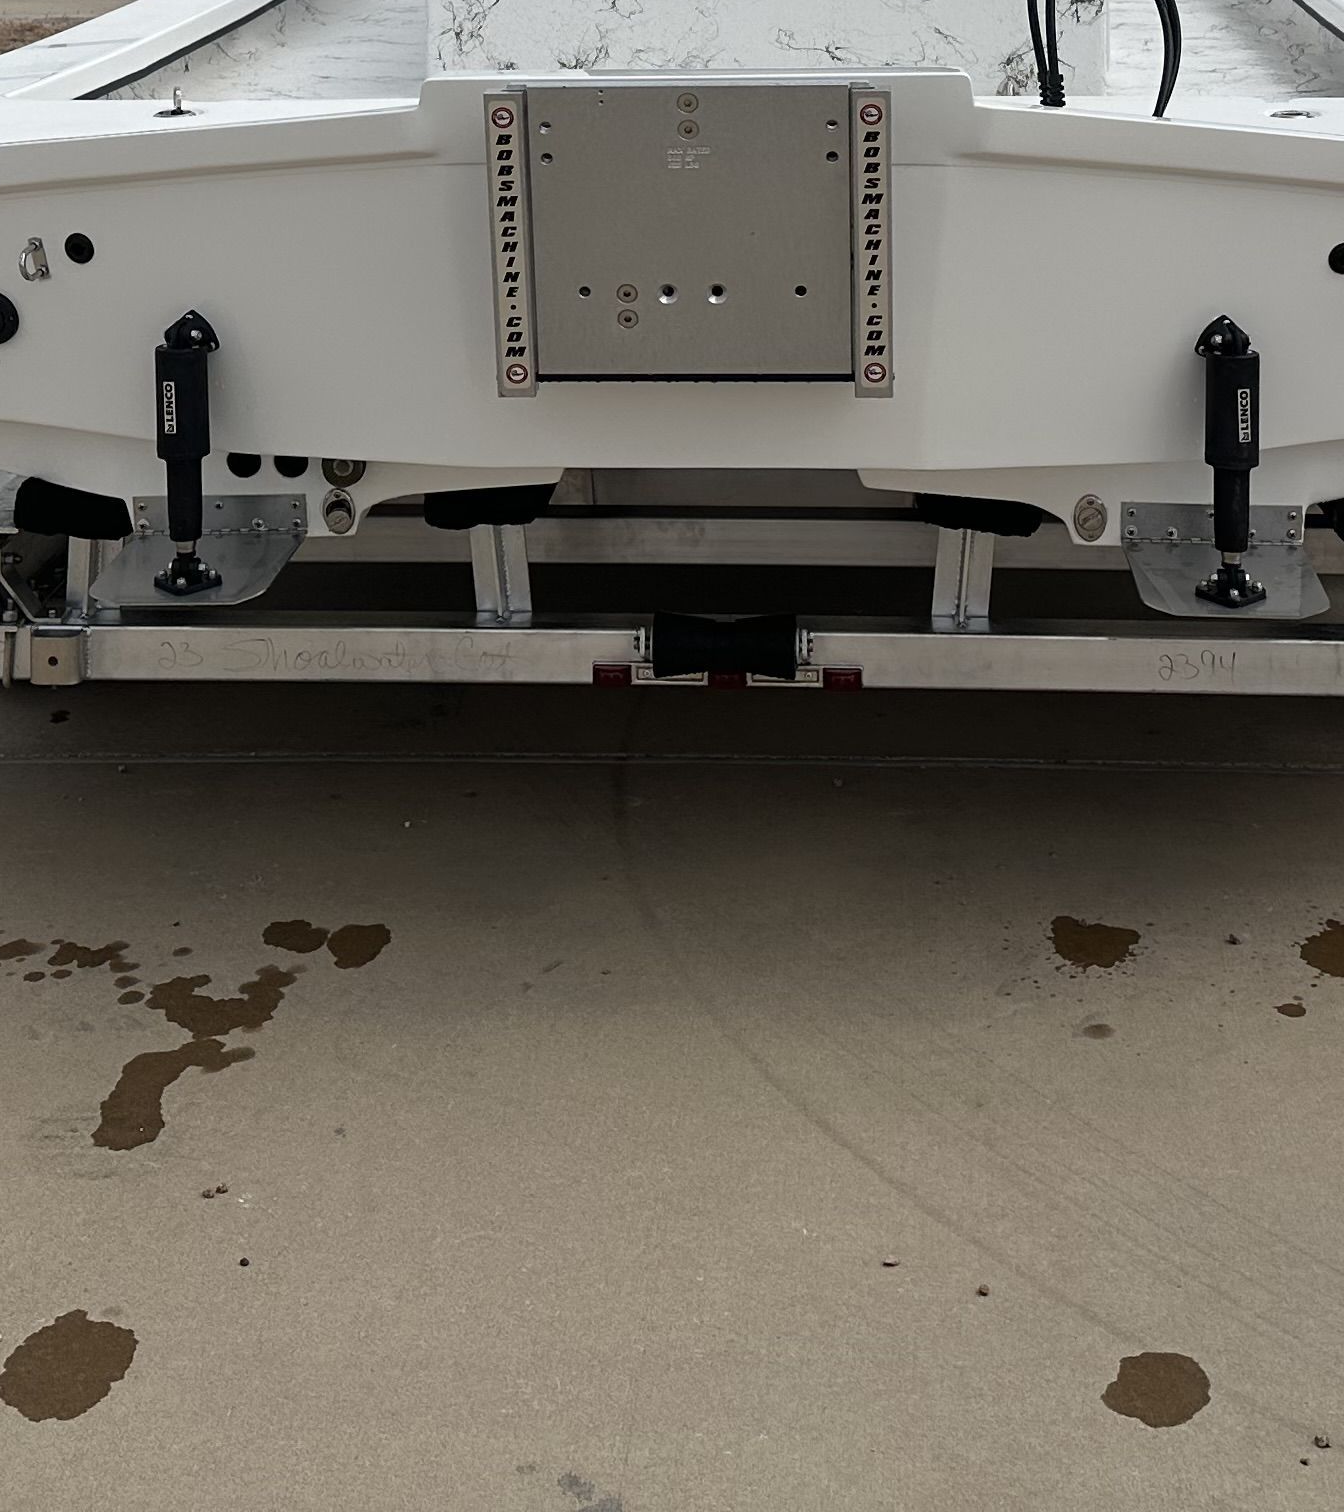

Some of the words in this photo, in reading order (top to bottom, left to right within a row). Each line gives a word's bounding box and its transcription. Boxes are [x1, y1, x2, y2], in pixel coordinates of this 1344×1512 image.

[165, 383, 174, 423] LENCO
[1239, 390, 1249, 431] LENCO
[158, 641, 204, 671] 23
